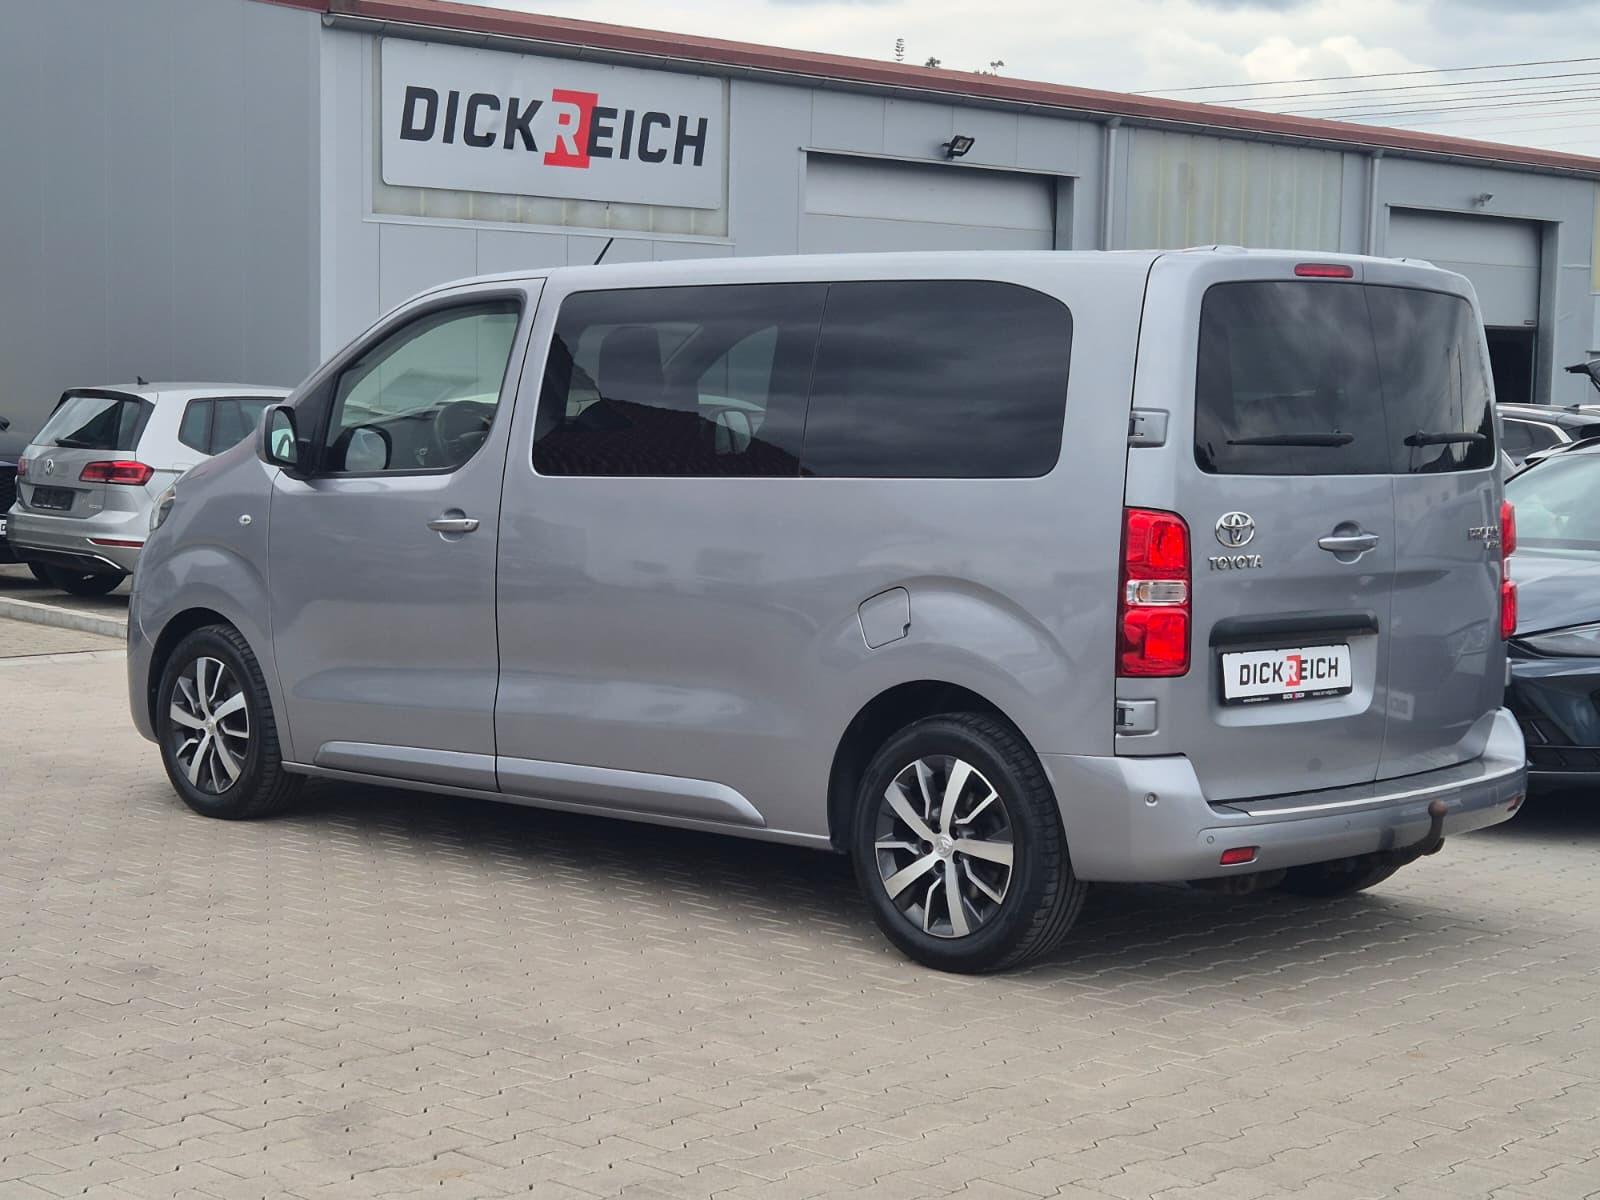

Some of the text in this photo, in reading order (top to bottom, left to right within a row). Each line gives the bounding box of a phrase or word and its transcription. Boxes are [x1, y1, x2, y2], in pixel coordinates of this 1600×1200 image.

[400, 85, 708, 167] DICKREICH
[1208, 554, 1263, 570] TOYOTA
[1239, 655, 1339, 686] DICKREICH
